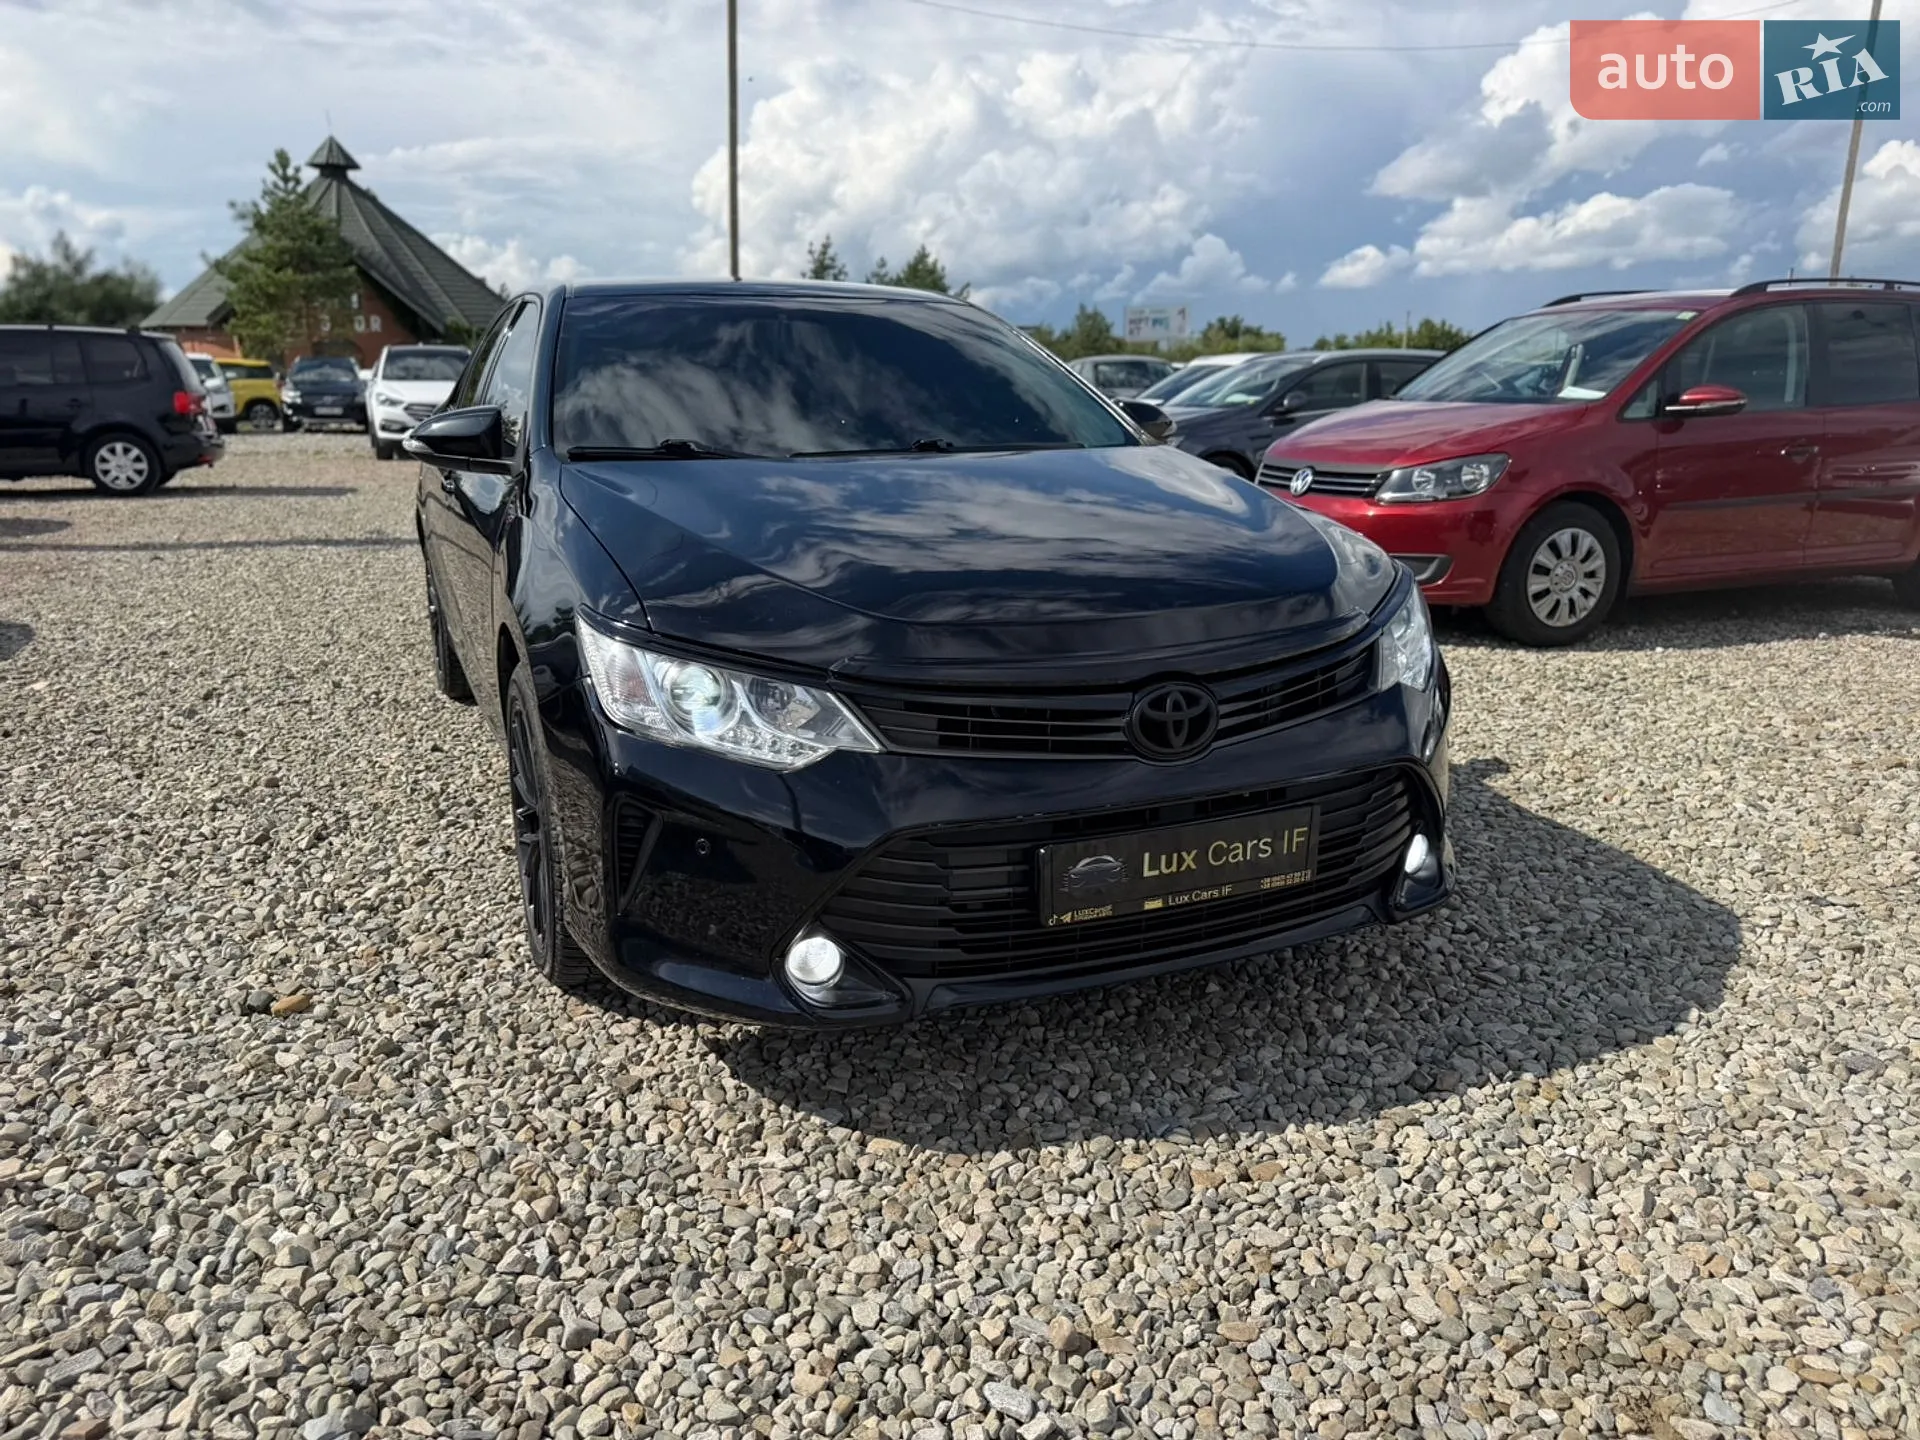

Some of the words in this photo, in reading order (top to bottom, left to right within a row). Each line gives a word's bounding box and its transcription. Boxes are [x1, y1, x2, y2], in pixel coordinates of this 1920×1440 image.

[1142, 849, 1198, 878] Lux
[1207, 836, 1272, 866] Cars
[1283, 827, 1309, 854] IF
[1168, 894, 1190, 906] Lux
[1191, 888, 1219, 902] Cars
[1221, 885, 1233, 897] IF
